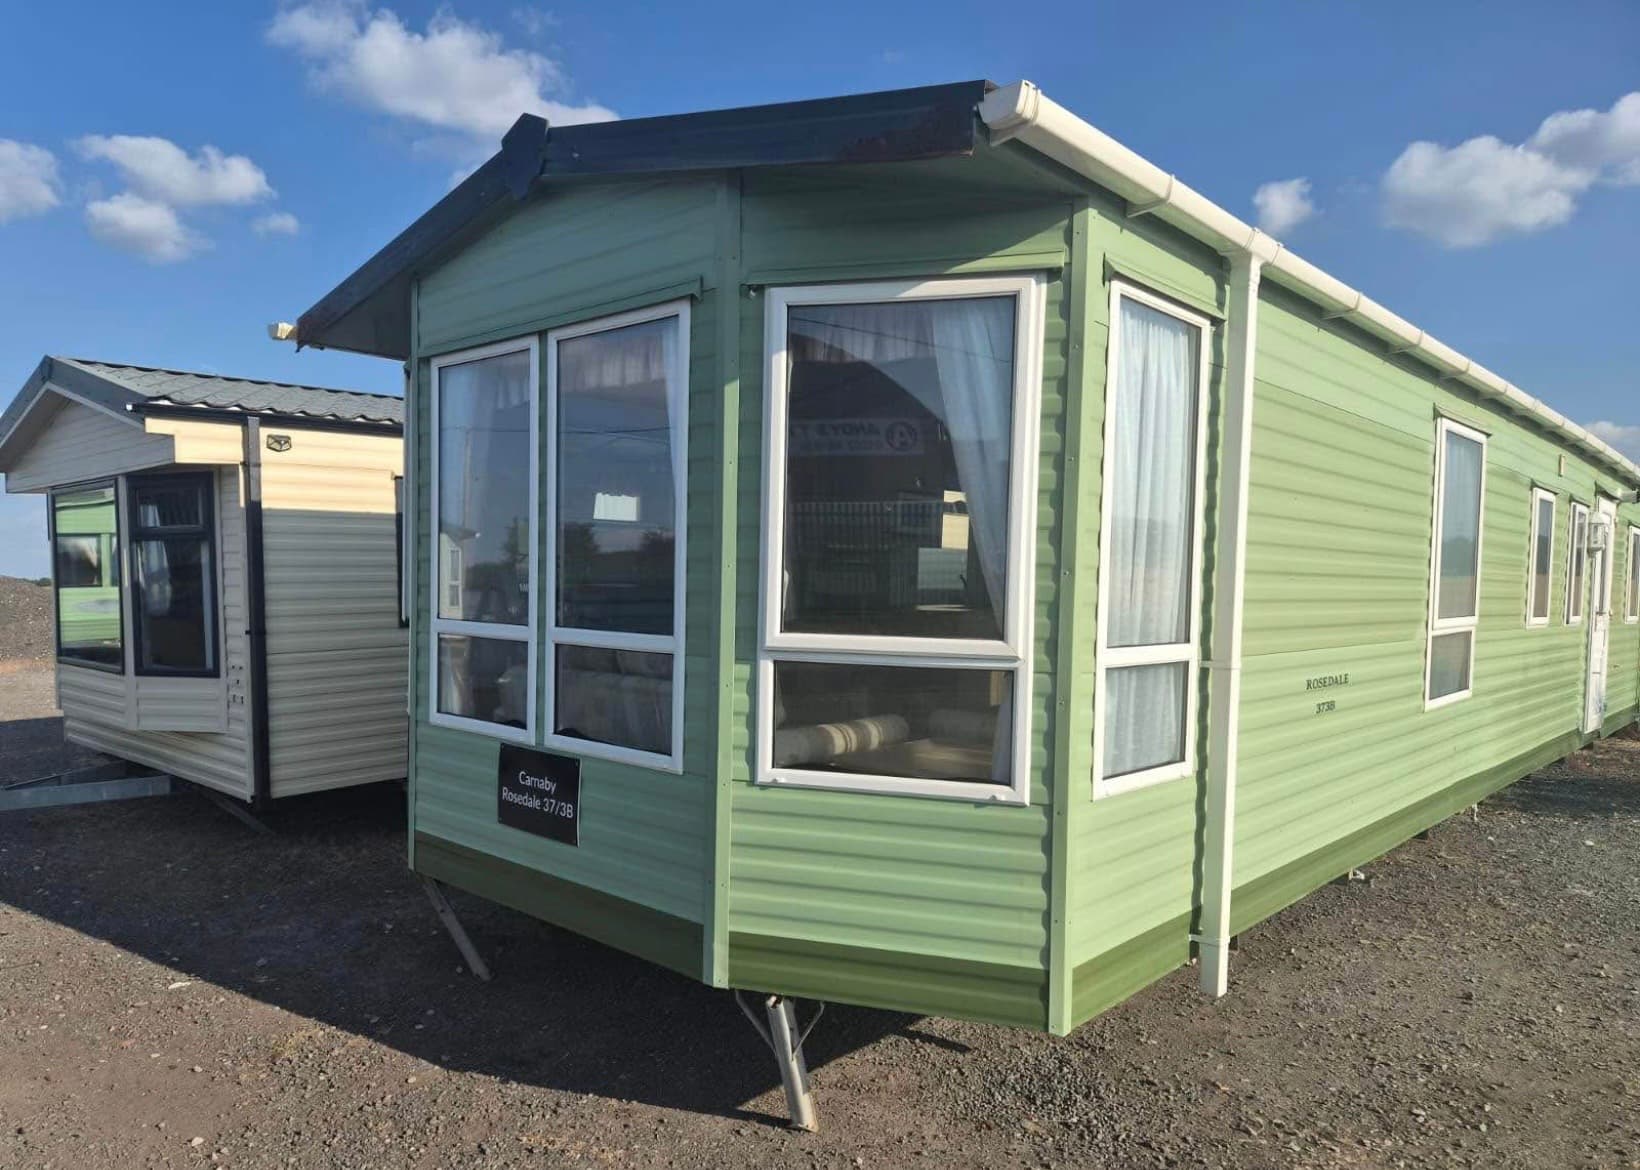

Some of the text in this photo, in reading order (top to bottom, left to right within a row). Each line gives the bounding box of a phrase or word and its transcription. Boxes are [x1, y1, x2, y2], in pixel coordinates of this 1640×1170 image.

[1305, 673, 1349, 690] ROSEDALE
[519, 771, 556, 795] Carnaby
[502, 786, 574, 818] Rosedale 37/3B
